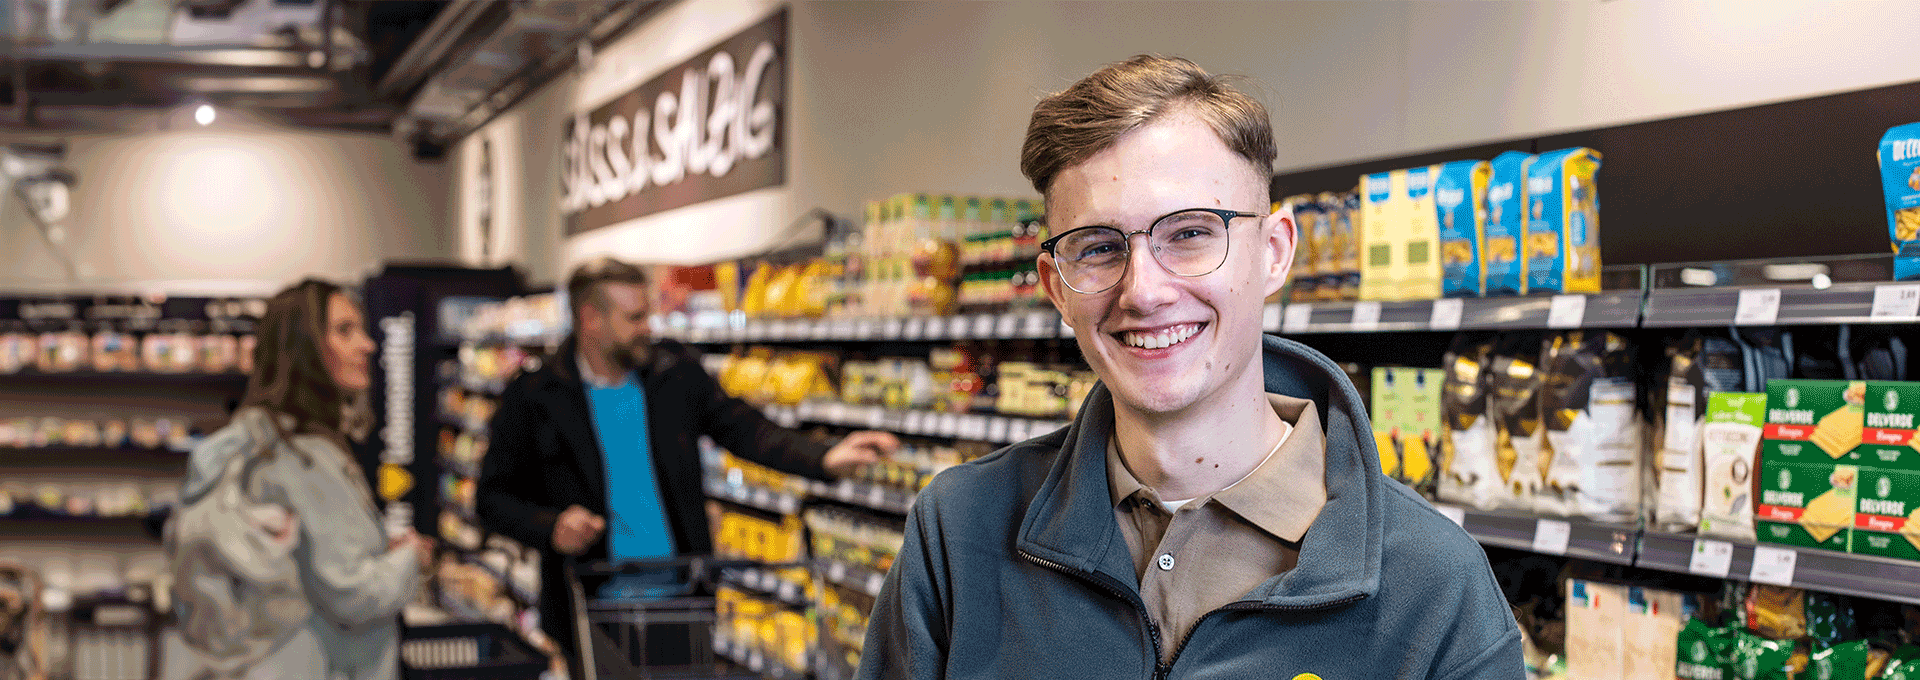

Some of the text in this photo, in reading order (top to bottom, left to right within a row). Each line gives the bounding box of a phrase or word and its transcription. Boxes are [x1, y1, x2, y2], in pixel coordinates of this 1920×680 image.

[1769, 409, 1813, 424] DELVERDE
[1867, 412, 1914, 428] DELVERDE
[1763, 490, 1804, 506] DELVERDE
[1859, 498, 1904, 515] DELVERDE
